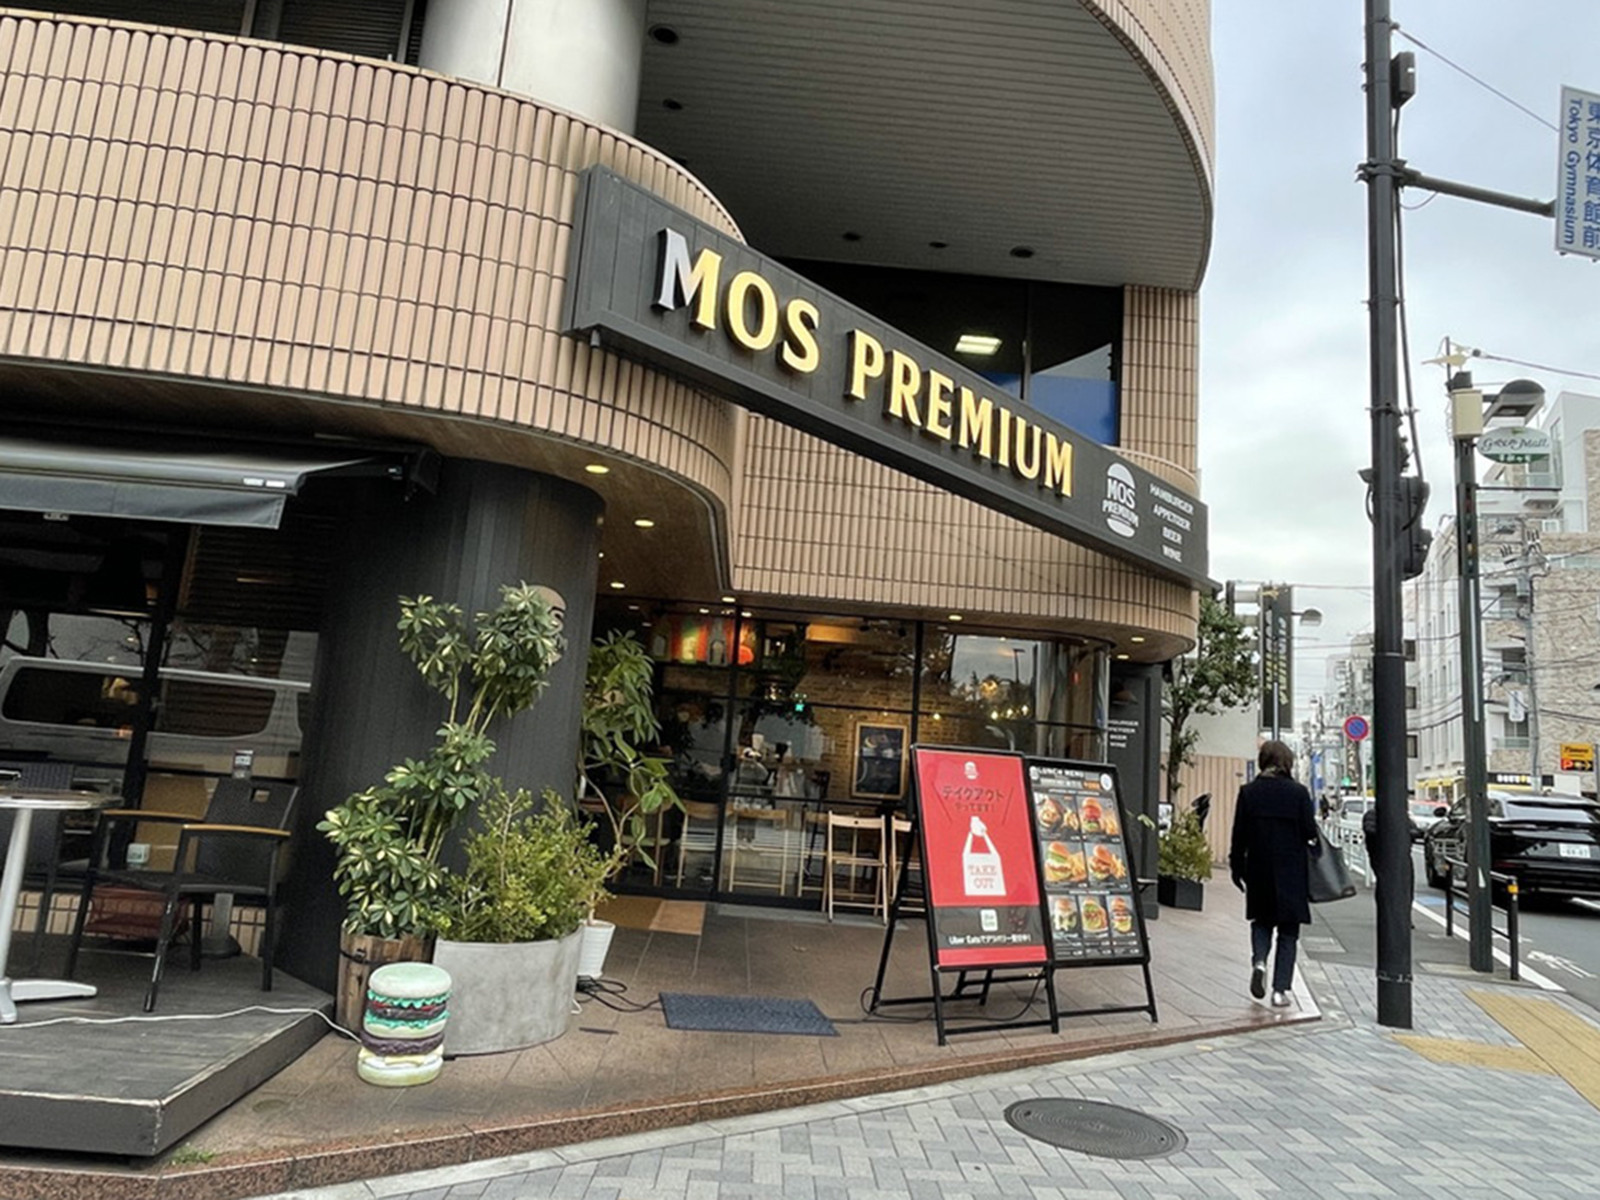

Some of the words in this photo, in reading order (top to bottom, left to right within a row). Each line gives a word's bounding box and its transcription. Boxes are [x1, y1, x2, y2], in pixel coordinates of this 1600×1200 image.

[1566, 98, 1582, 144] Tokyo
[1564, 150, 1581, 245] Gymnasium
[654, 228, 819, 373] MOS
[847, 328, 1073, 498] PREMIUM
[1107, 478, 1136, 510] MOS
[942, 786, 1004, 801] テイクアウト
[968, 865, 997, 876] TAKE
[974, 878, 995, 889] OUT
